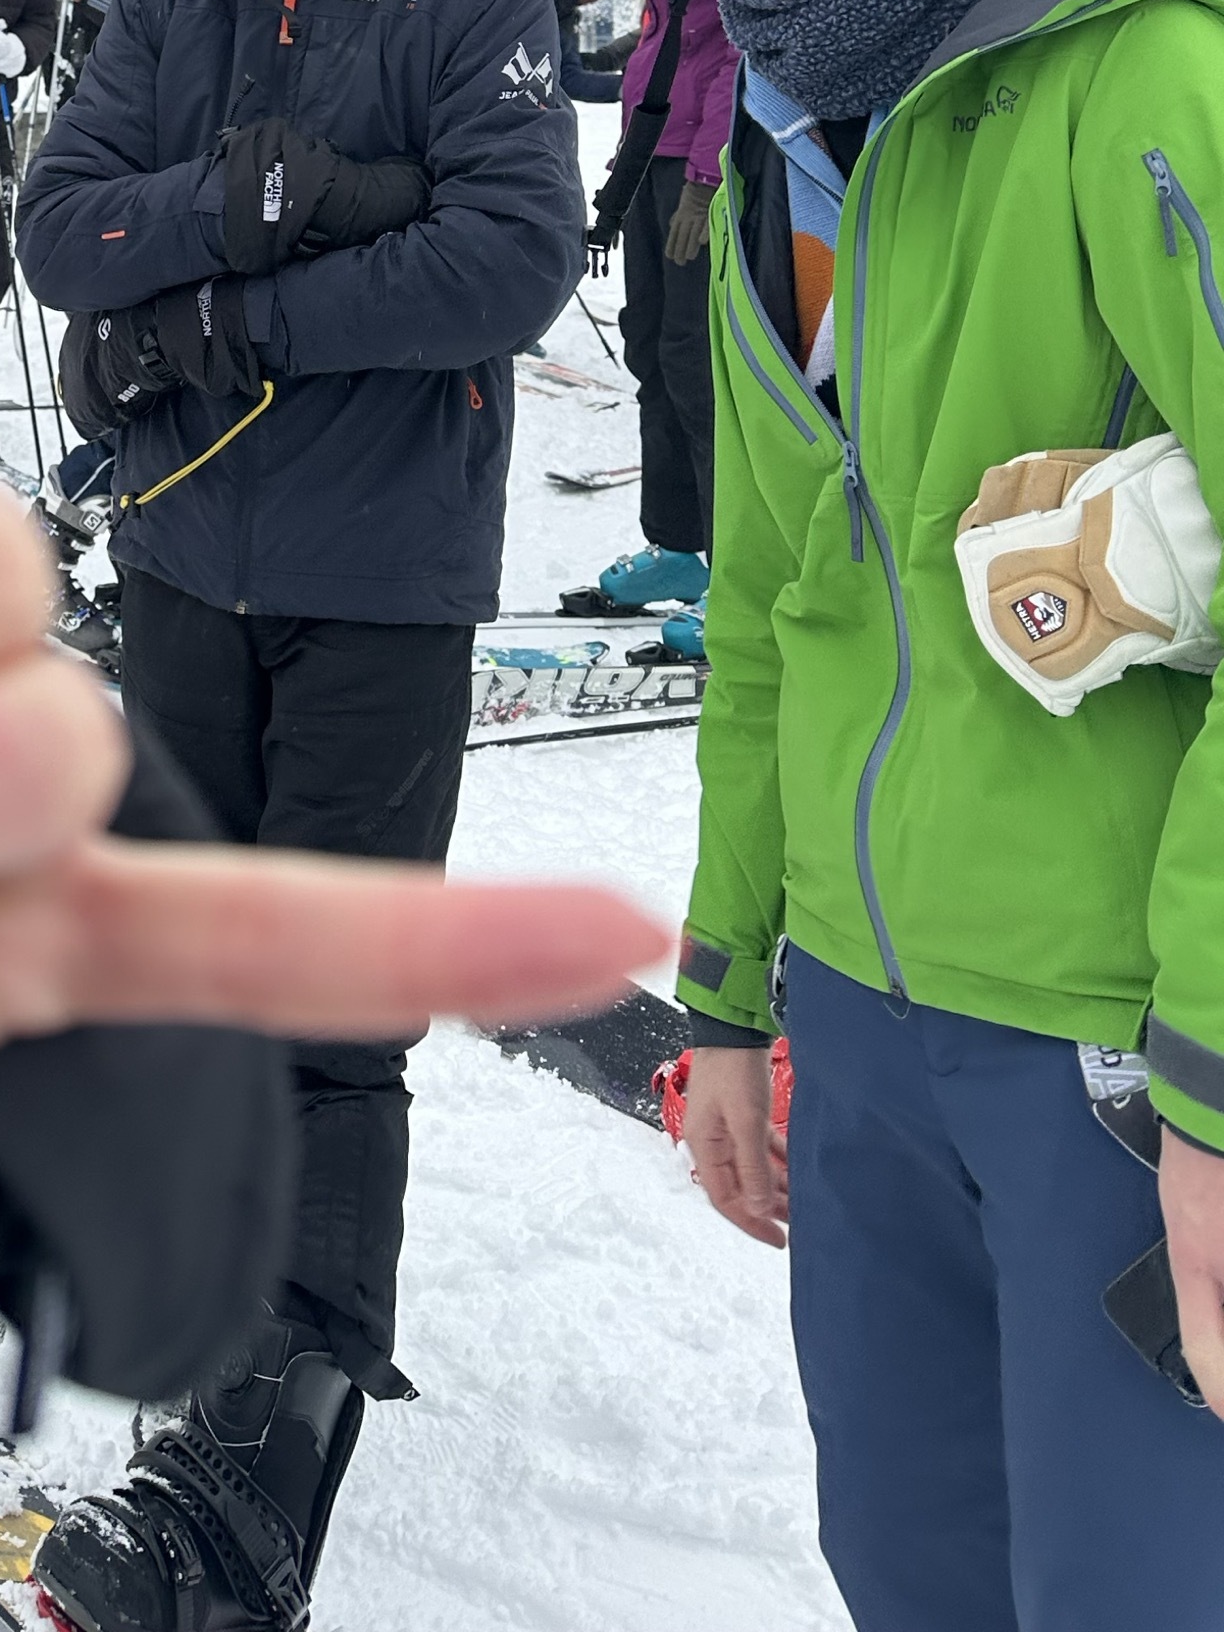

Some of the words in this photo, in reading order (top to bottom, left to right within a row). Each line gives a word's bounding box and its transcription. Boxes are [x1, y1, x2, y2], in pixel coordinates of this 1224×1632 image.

[264, 172, 274, 201] FACE
[273, 162, 284, 202] NORTH
[202, 298, 213, 336] NORTH
[117, 383, 141, 403] 800
[1016, 602, 1042, 640] HESTRA
